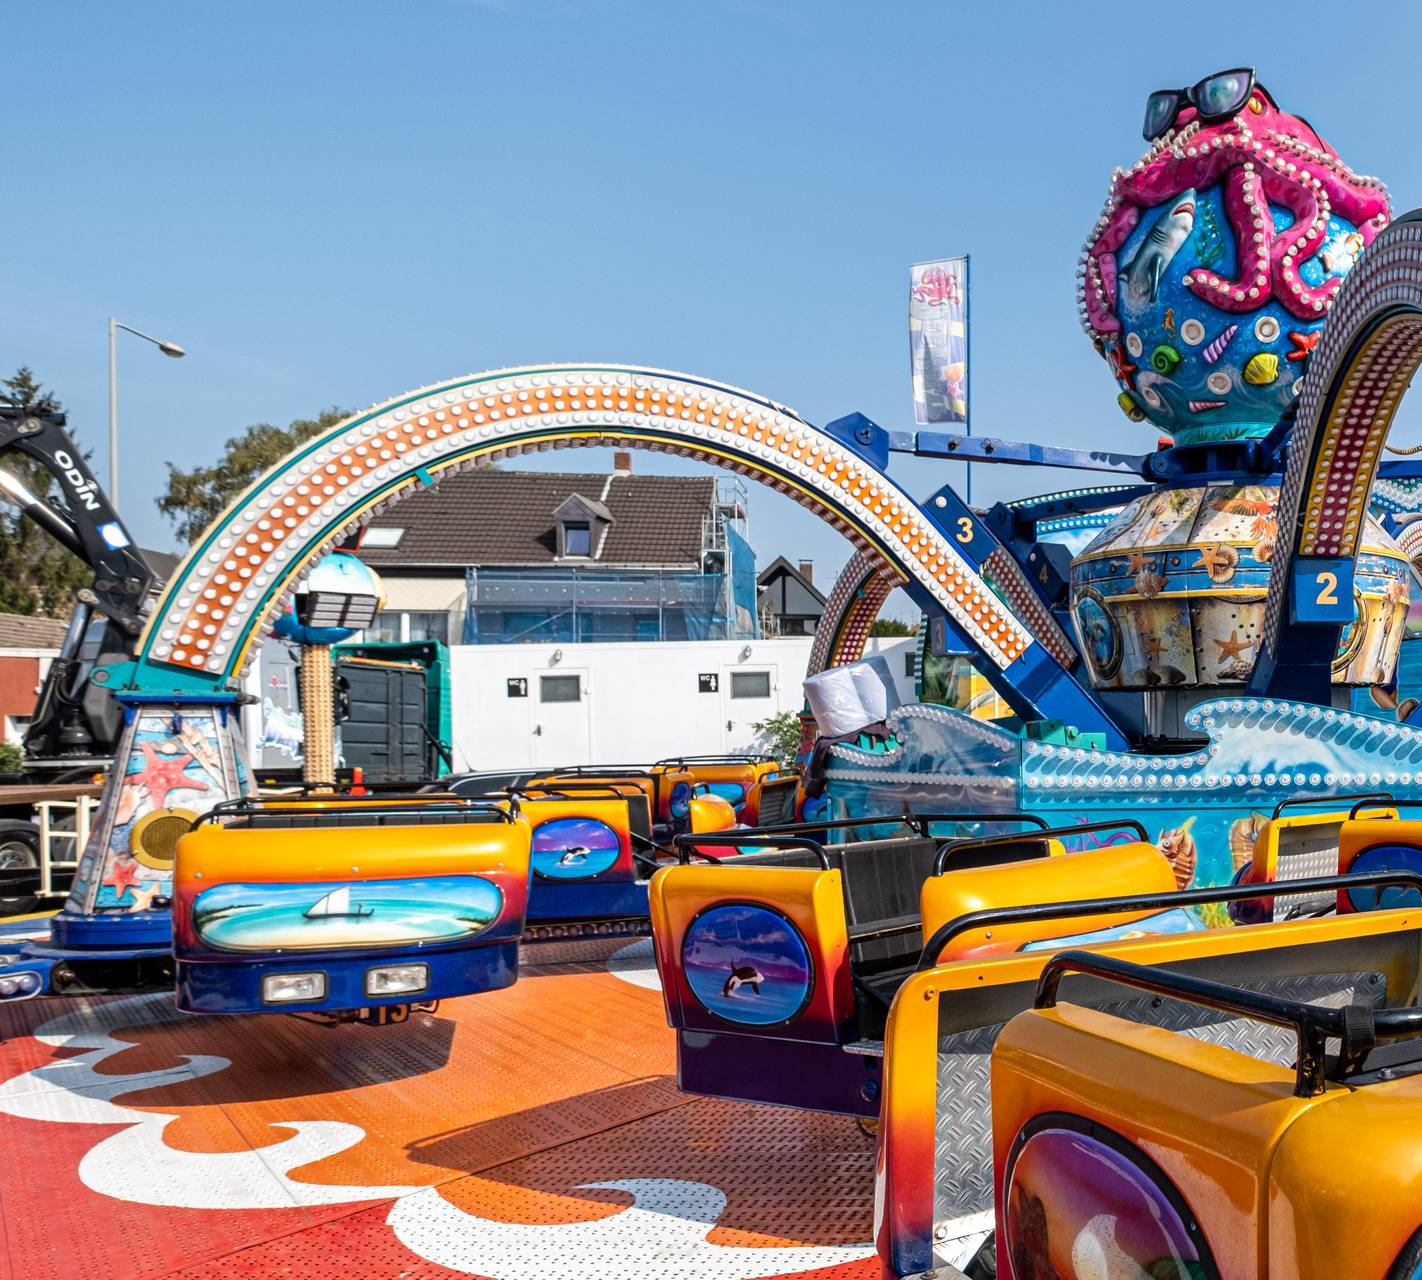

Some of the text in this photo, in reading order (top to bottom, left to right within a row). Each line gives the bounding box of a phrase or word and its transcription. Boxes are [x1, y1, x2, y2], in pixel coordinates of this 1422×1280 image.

[54, 449, 101, 511] ODIN
[955, 517, 974, 543] 3
[1038, 564, 1049, 584] 4
[1316, 571, 1338, 604] 2
